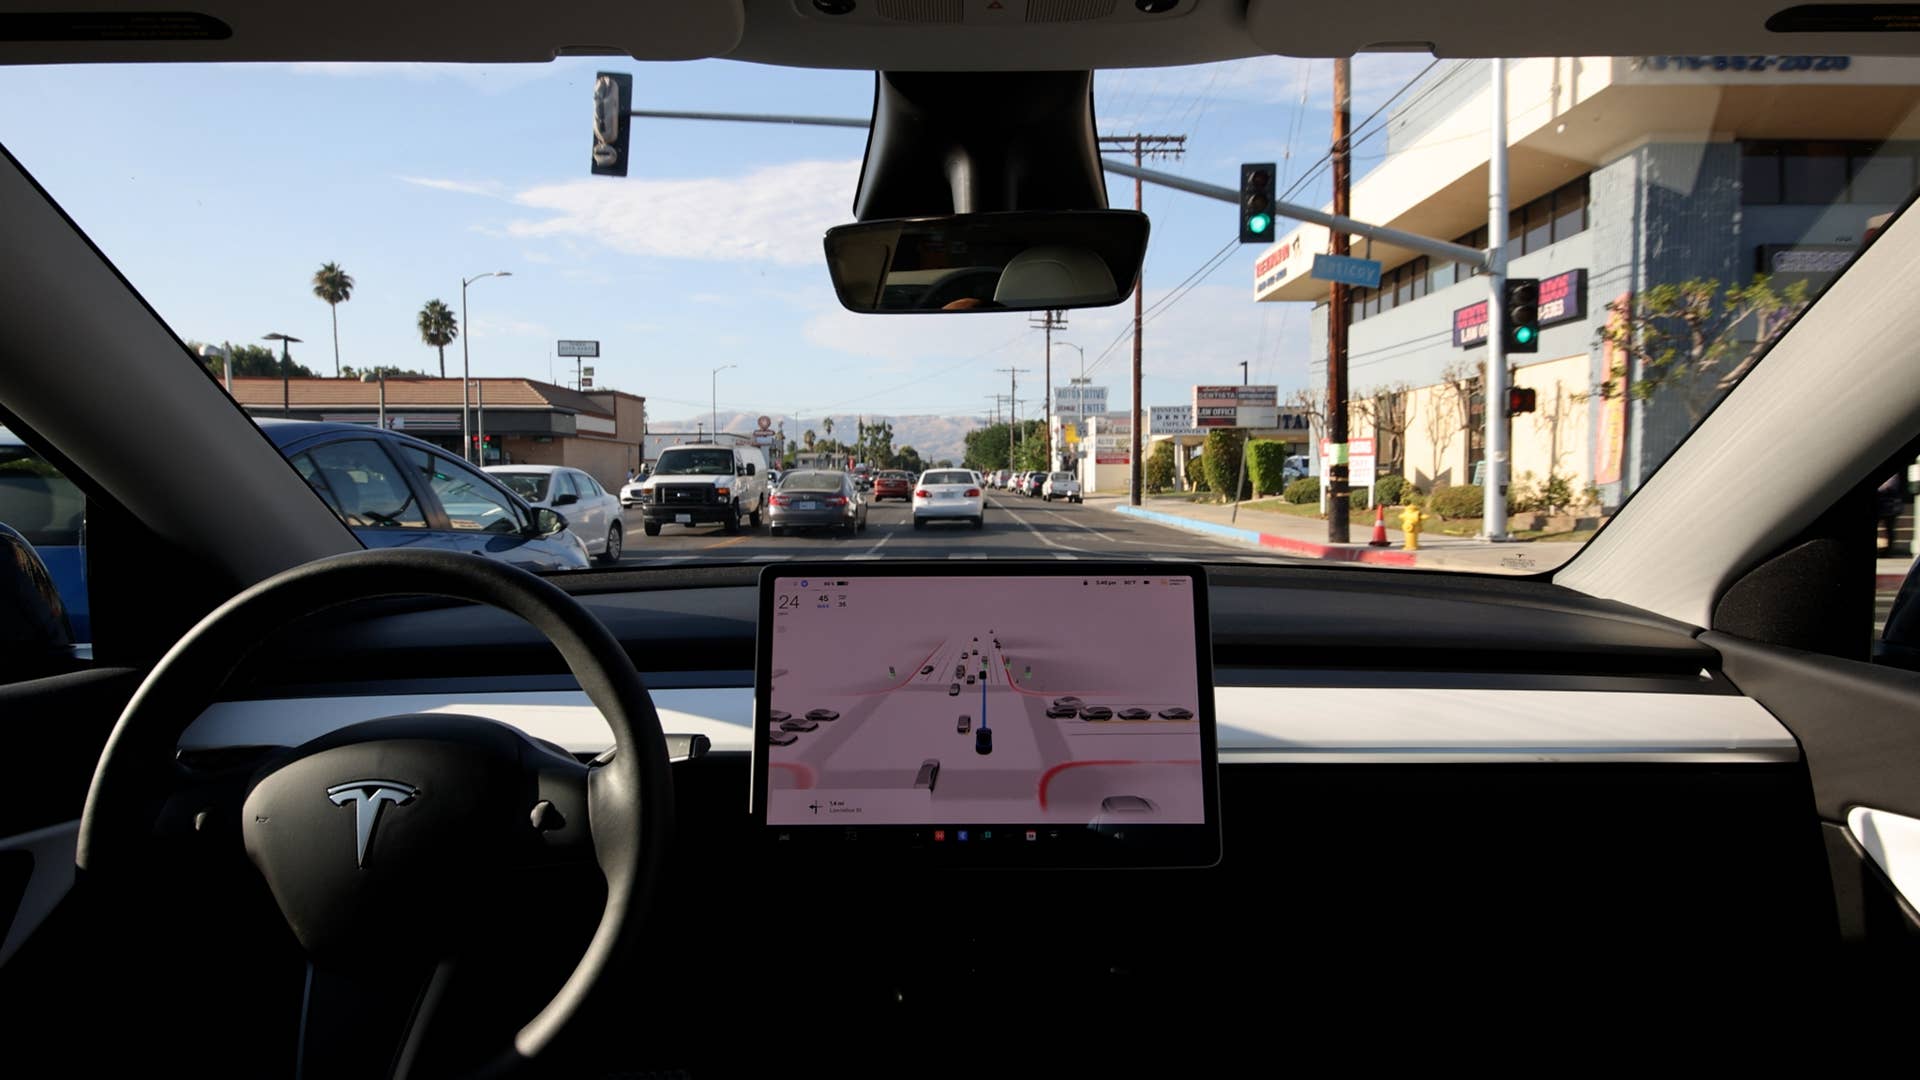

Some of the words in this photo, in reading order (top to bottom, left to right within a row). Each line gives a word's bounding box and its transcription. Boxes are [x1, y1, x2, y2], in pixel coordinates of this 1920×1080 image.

[1198, 407, 1211, 416] LAW
[1212, 407, 1235, 416] OFFICE
[779, 594, 799, 609] 24
